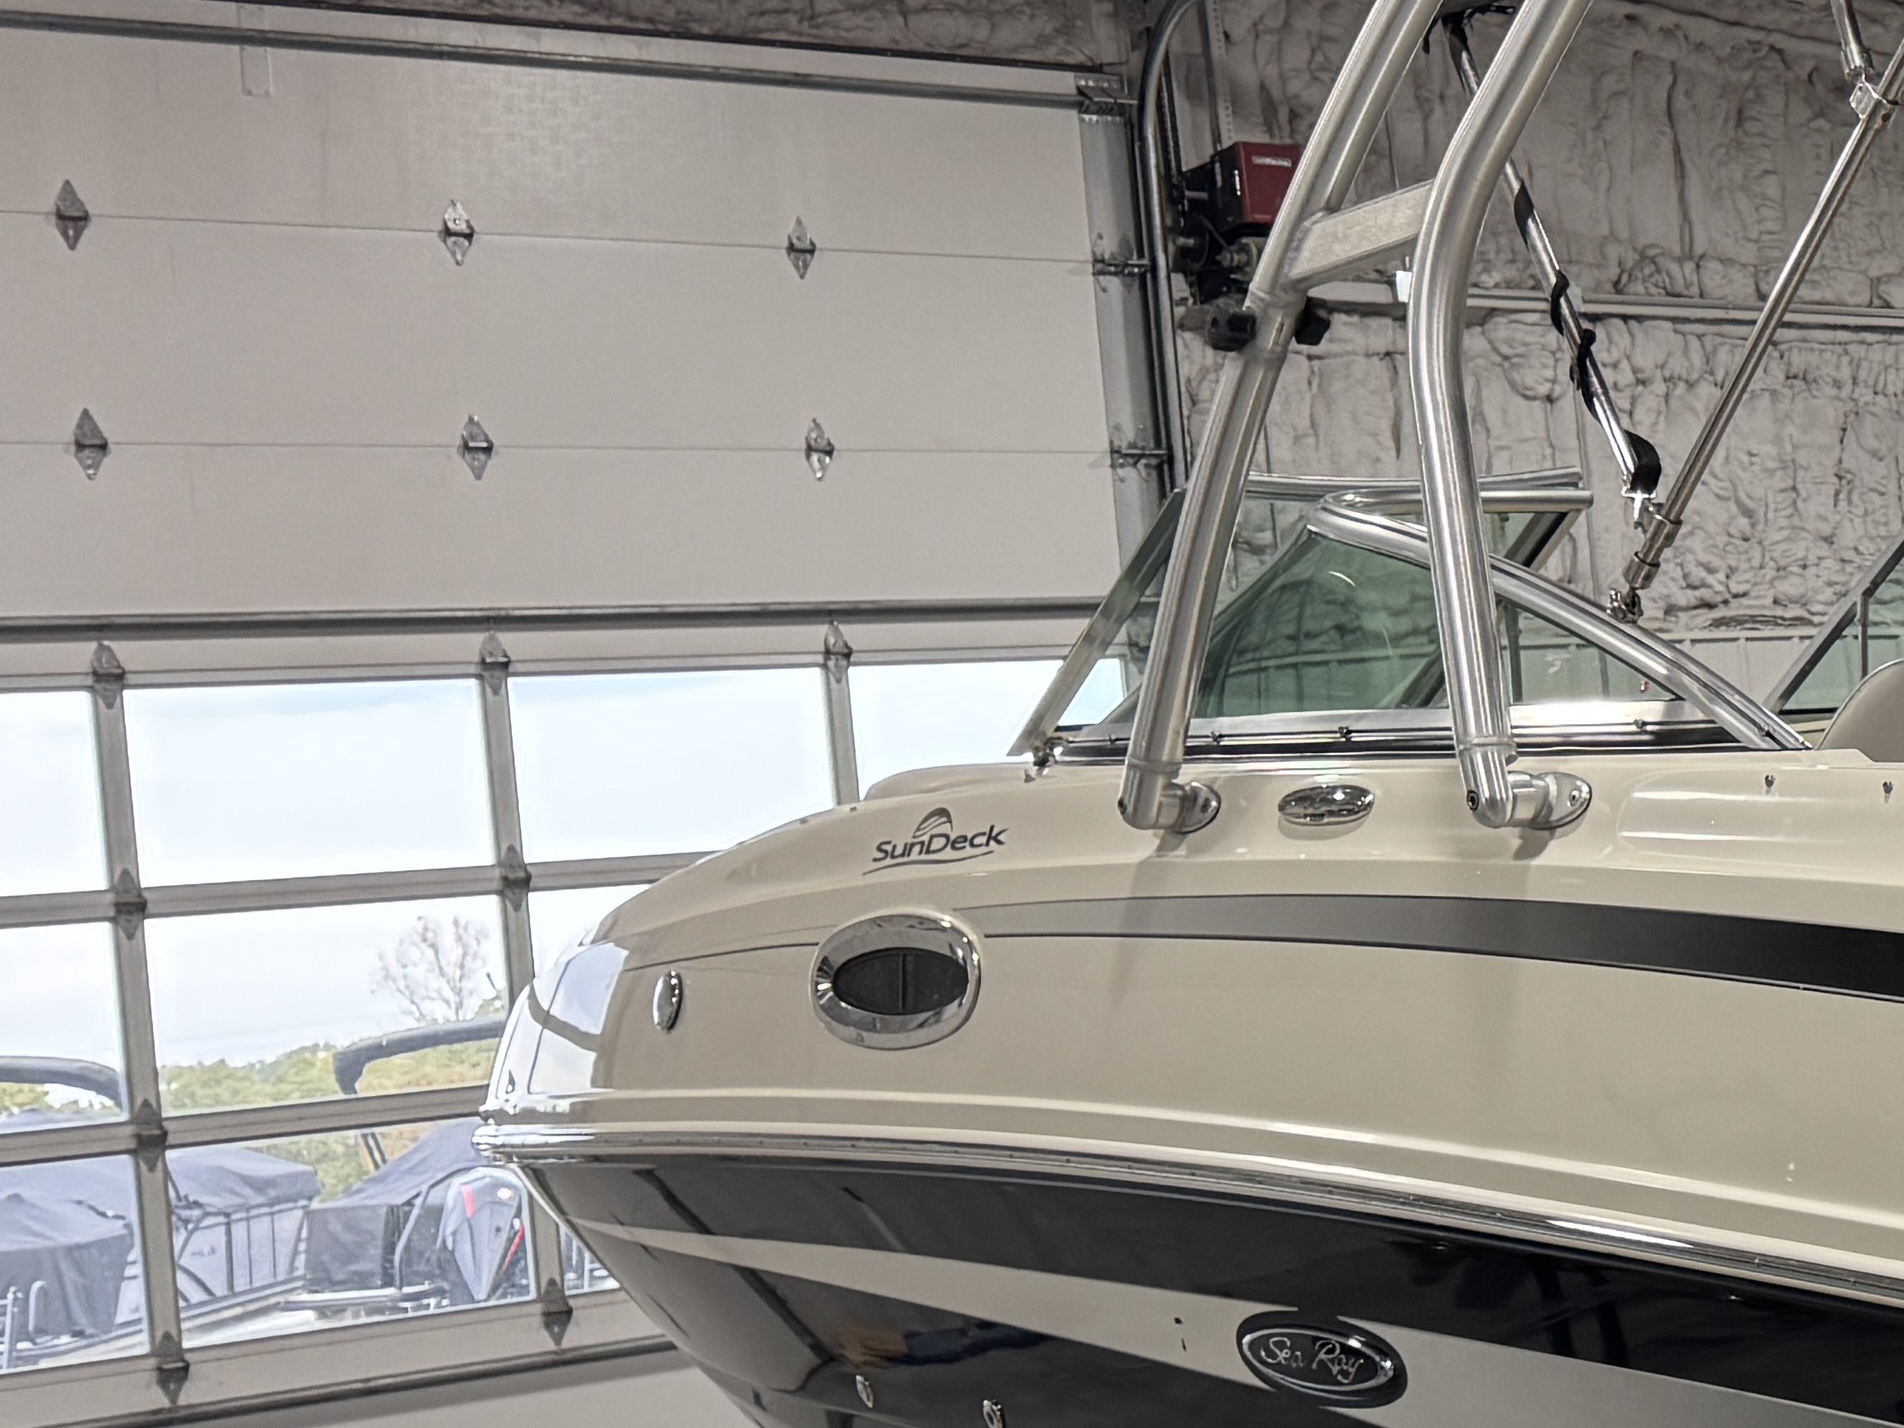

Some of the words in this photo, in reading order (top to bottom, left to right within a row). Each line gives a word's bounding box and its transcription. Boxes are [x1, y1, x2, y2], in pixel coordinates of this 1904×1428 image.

[872, 824, 1009, 862] SunDeck
[1260, 1336, 1304, 1368] Sea
[1311, 1339, 1365, 1384] Ray
